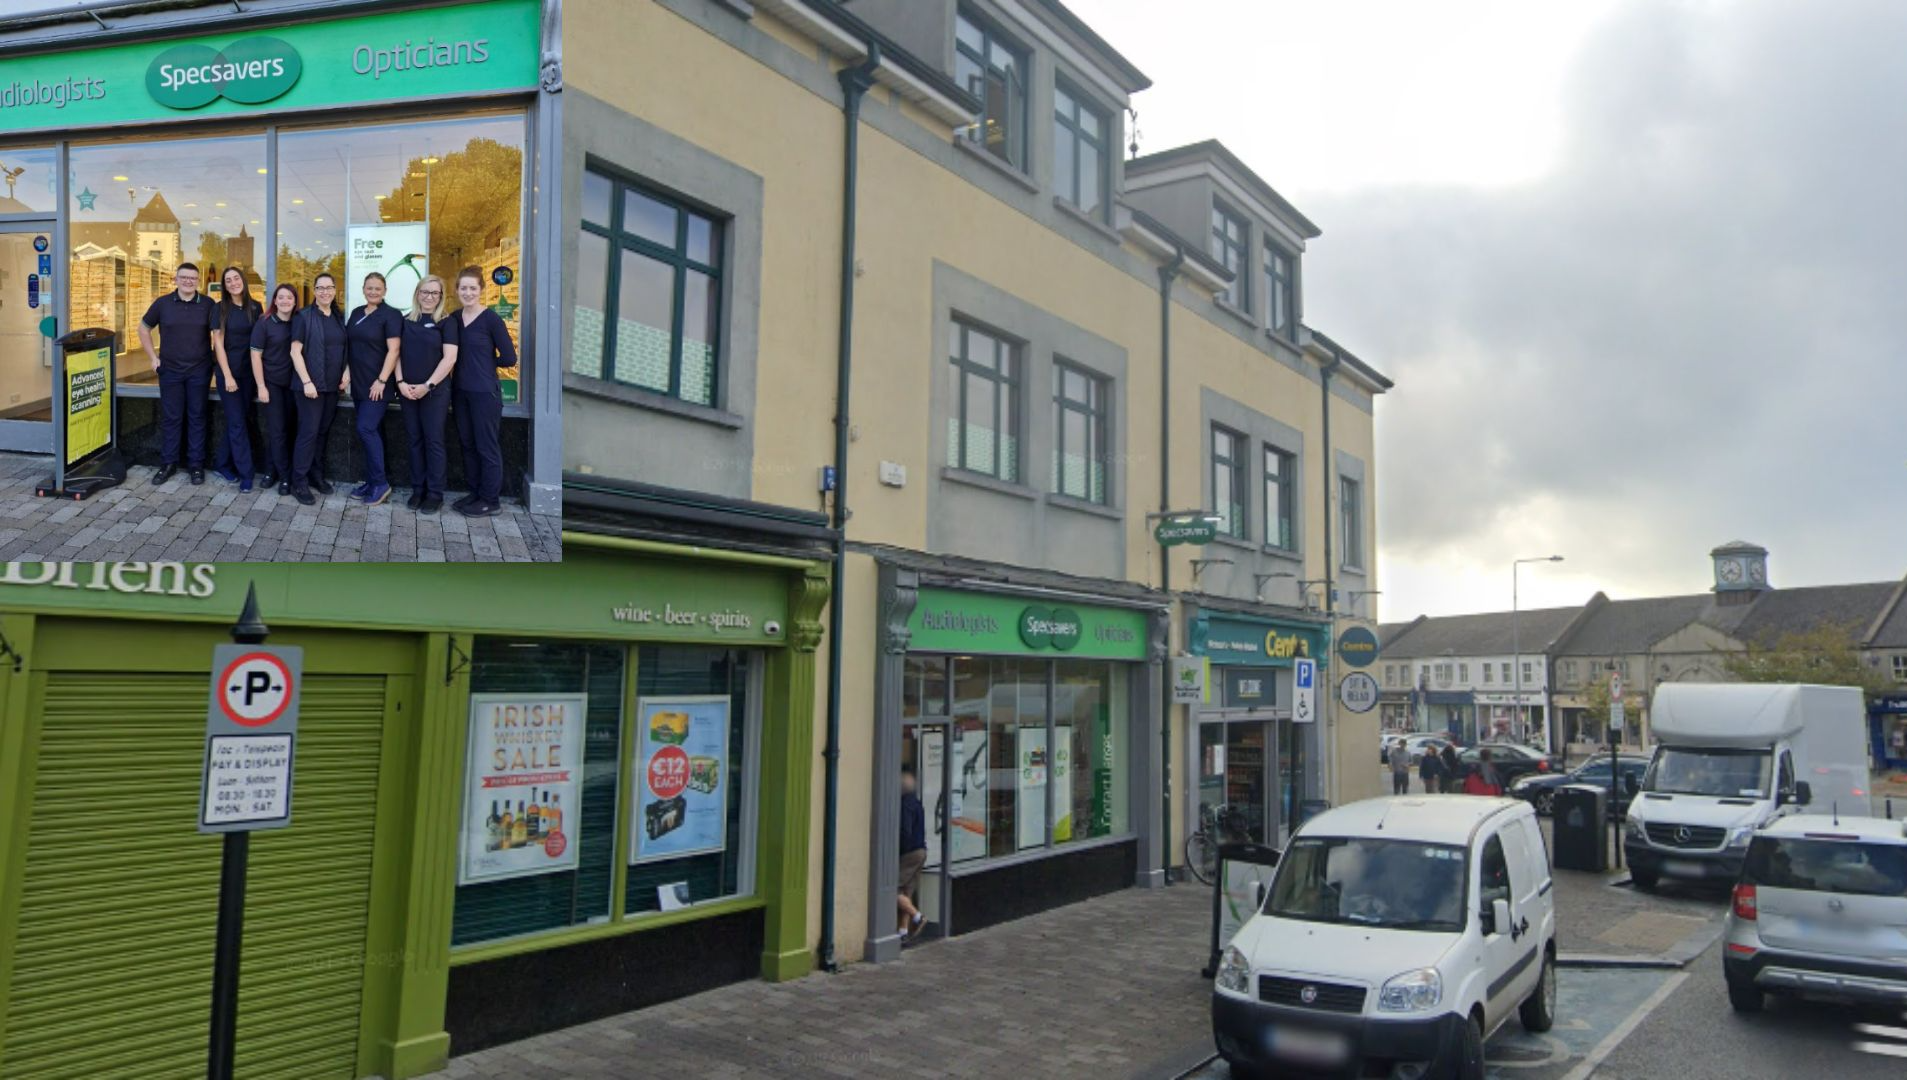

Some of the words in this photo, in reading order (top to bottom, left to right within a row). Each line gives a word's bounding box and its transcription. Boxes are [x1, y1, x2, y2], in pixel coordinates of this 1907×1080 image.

[352, 37, 489, 80] Opticians
[160, 58, 284, 91] Specsavers
[354, 238, 383, 249] Free
[71, 369, 105, 386] Advanced
[71, 387, 84, 400] eye
[85, 381, 105, 396] health
[71, 395, 101, 412] scanning
[613, 602, 651, 622] wine
[665, 603, 697, 625] beer
[709, 608, 751, 632] spirits
[922, 608, 998, 636] Audiologists
[1027, 616, 1077, 636] Specsavers
[1265, 630, 1309, 657] Centa
[1301, 664, 1309, 685] P
[244, 671, 270, 706] P
[494, 704, 564, 729] IRISH
[494, 729, 563, 744] WHISKEY
[212, 759, 232, 769] PAY
[244, 758, 287, 769] DISPLAY
[493, 745, 561, 771] SALE
[653, 757, 686, 776] €12
[654, 775, 683, 789] EACH
